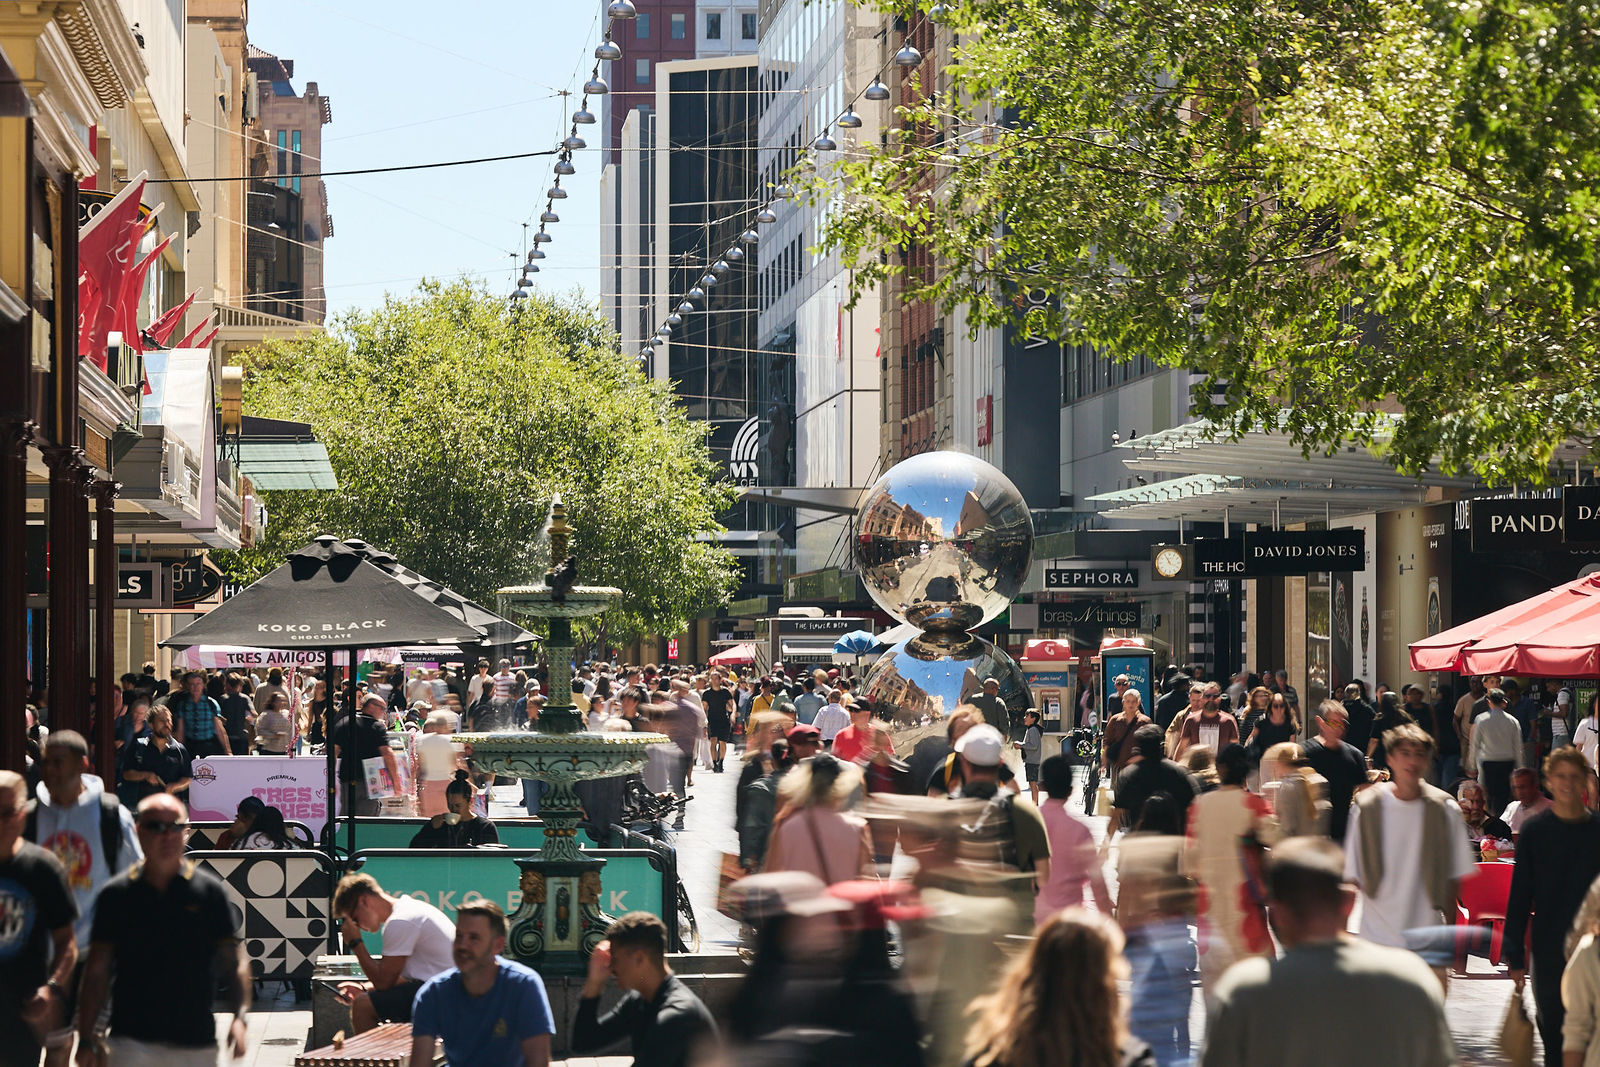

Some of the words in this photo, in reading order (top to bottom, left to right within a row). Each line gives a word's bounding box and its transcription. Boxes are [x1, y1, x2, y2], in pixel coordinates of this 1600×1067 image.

[1491, 515, 1563, 533] PAND
[1254, 546, 1302, 558] DAVID
[1306, 545, 1357, 557] JONES
[1203, 562, 1224, 572] THE
[1050, 573, 1134, 584] SEPHORA
[1043, 608, 1073, 622] bras
[1096, 608, 1137, 625] things
[258, 623, 312, 632] KOKO
[322, 619, 387, 632] BLACK
[795, 622, 807, 630] THE
[809, 622, 831, 630] FLOWER
[227, 652, 262, 664] TRES
[266, 652, 326, 665] AMIGOS
[266, 774, 297, 783] PREMIUM
[251, 787, 312, 803] TRES
